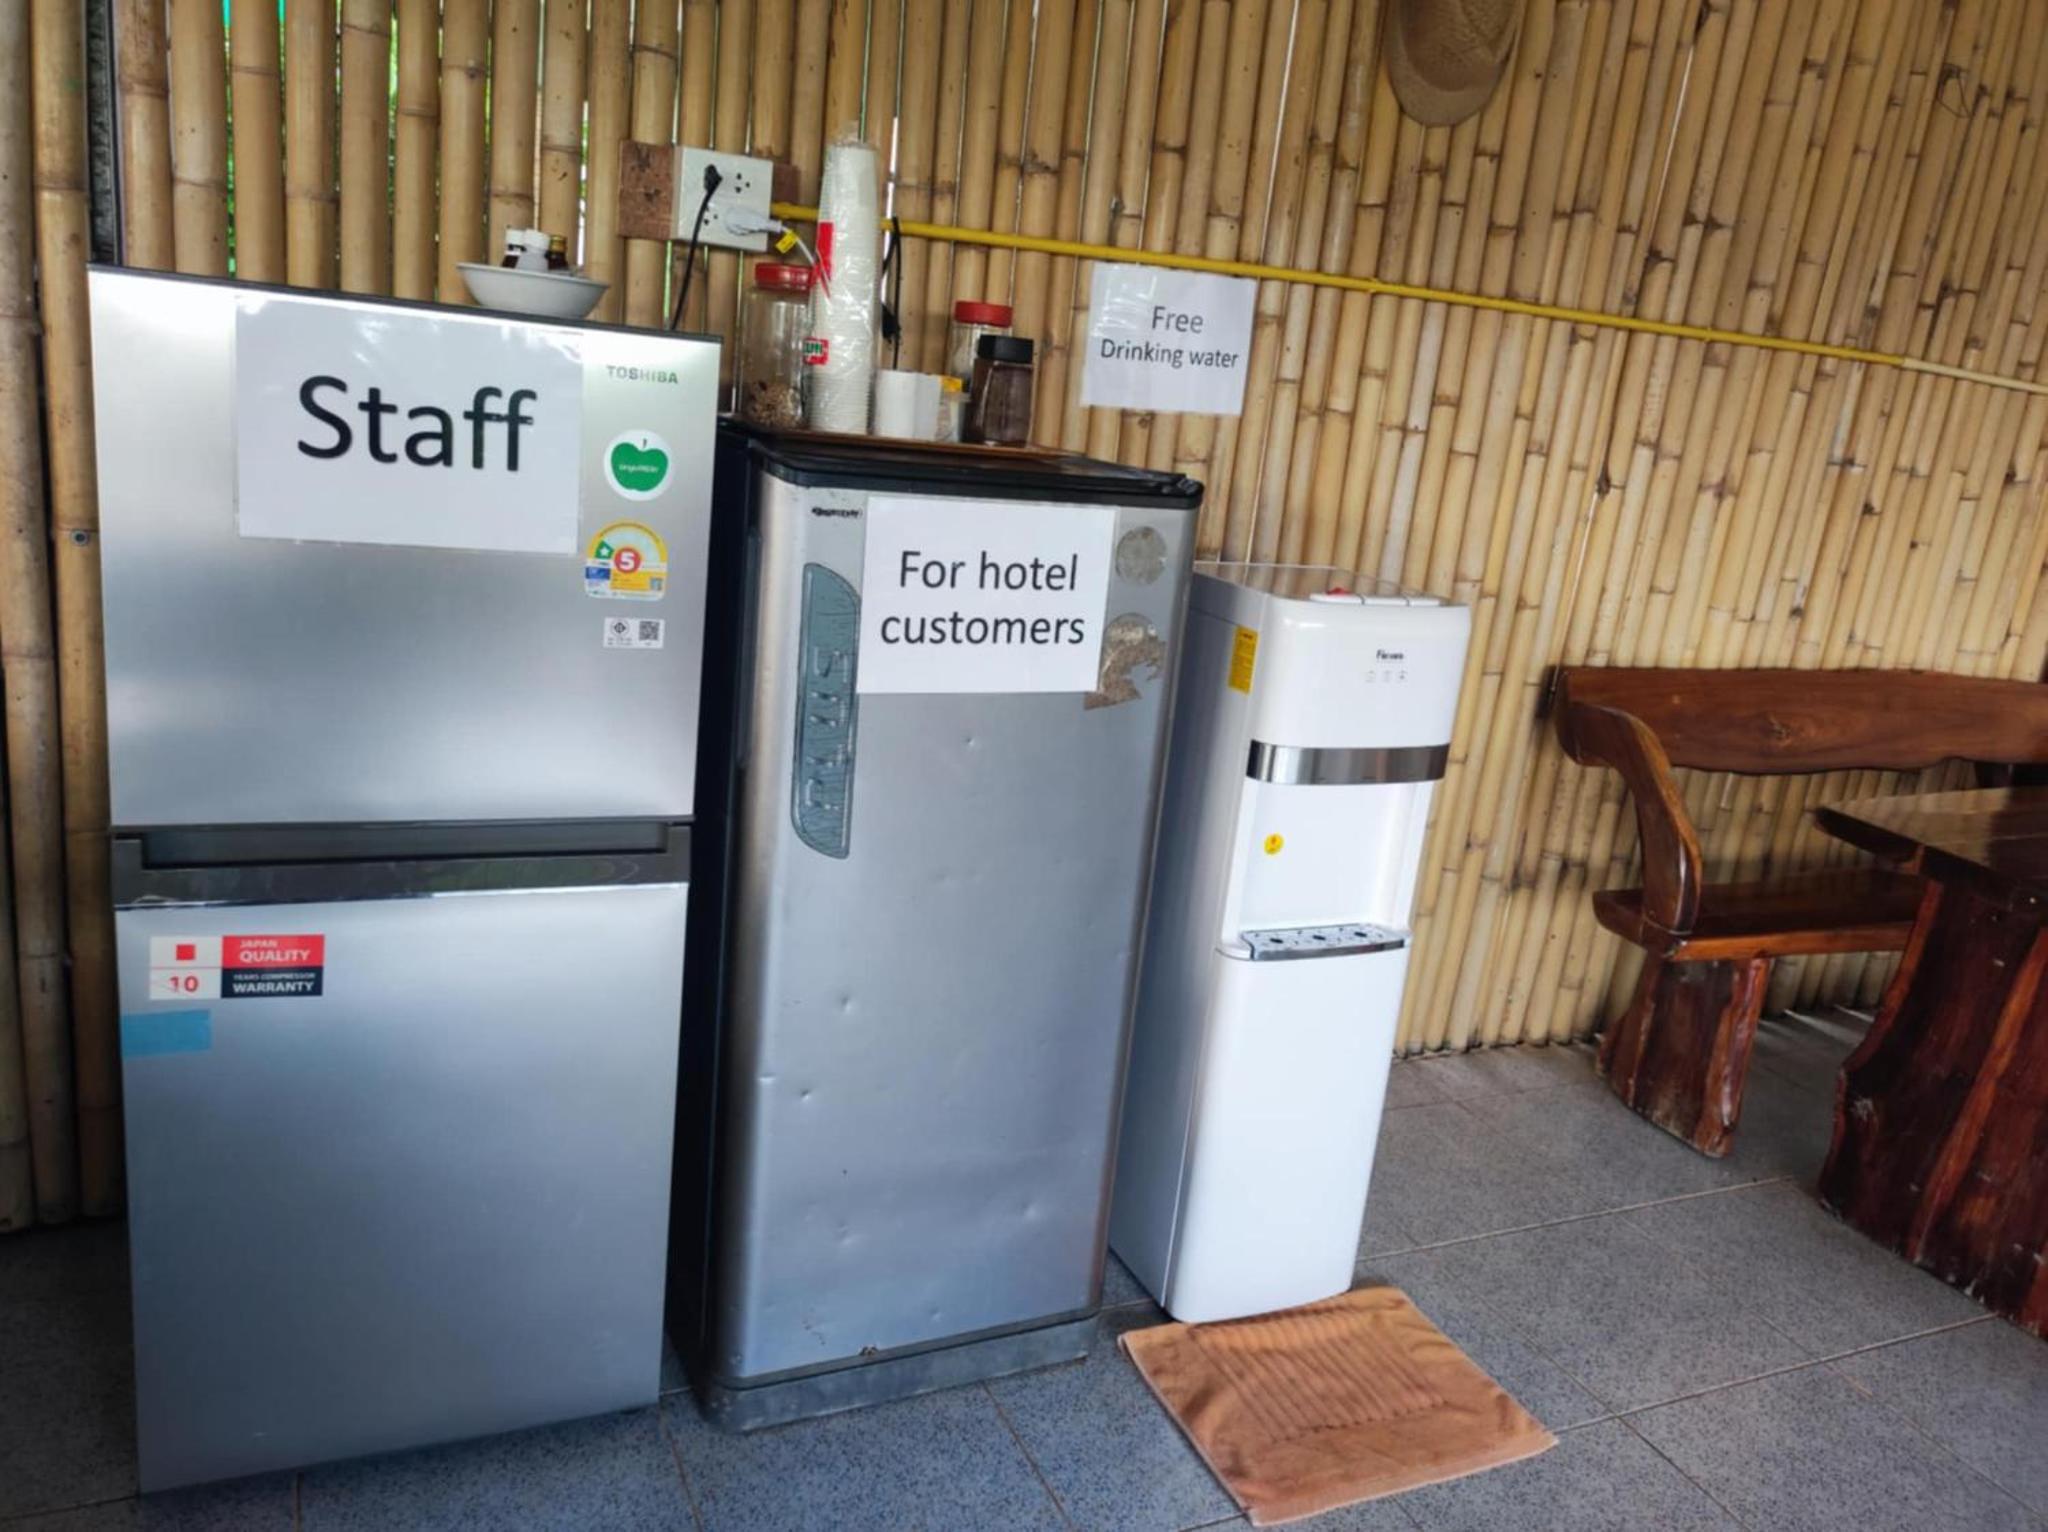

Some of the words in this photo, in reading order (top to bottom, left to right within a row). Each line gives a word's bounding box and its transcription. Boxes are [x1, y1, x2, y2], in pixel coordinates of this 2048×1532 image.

[1152, 305, 1204, 333] Free
[1100, 338, 1183, 369] Drinking
[1189, 350, 1239, 368] water
[606, 365, 678, 384] TOSHIBA
[297, 375, 538, 472] Staff
[619, 551, 635, 571] 5
[900, 550, 966, 589] For
[978, 550, 1078, 591] hotel
[881, 611, 1085, 645] customers
[239, 949, 311, 964] QUALITY
[232, 981, 314, 994] WARRANTY
